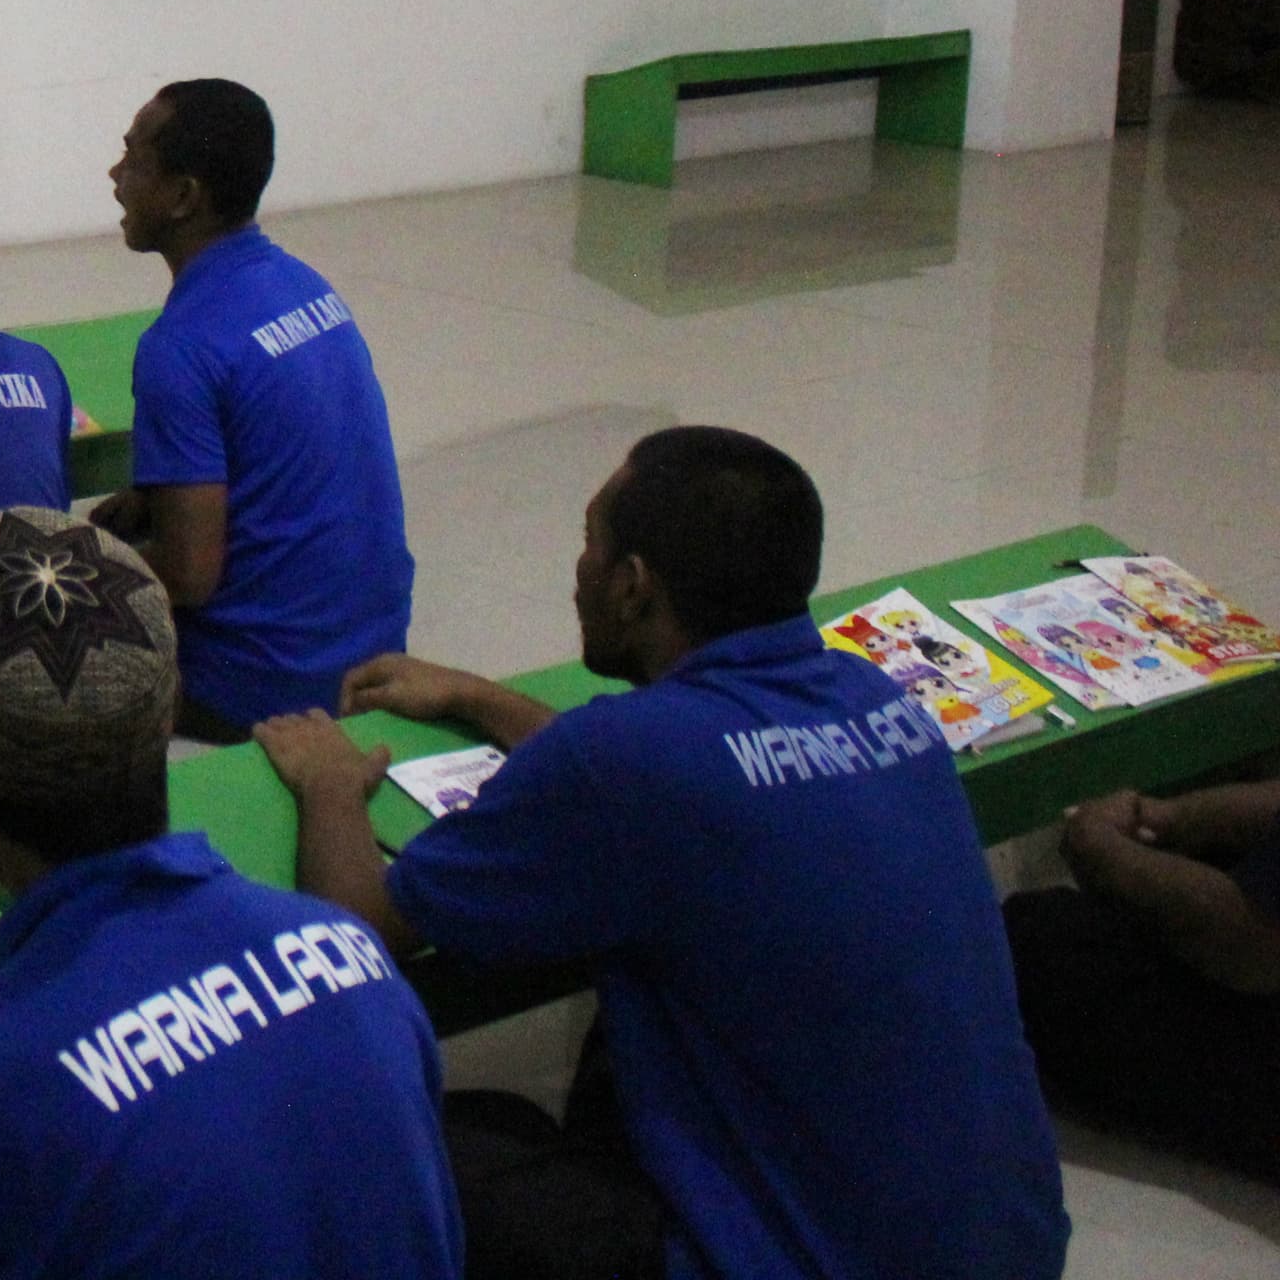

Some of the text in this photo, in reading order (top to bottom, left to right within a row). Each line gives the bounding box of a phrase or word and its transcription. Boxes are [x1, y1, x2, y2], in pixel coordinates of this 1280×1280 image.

[251, 308, 320, 358] WARNA
[723, 723, 871, 787] WARNA
[58, 922, 393, 1113] WARNA LACIKA
